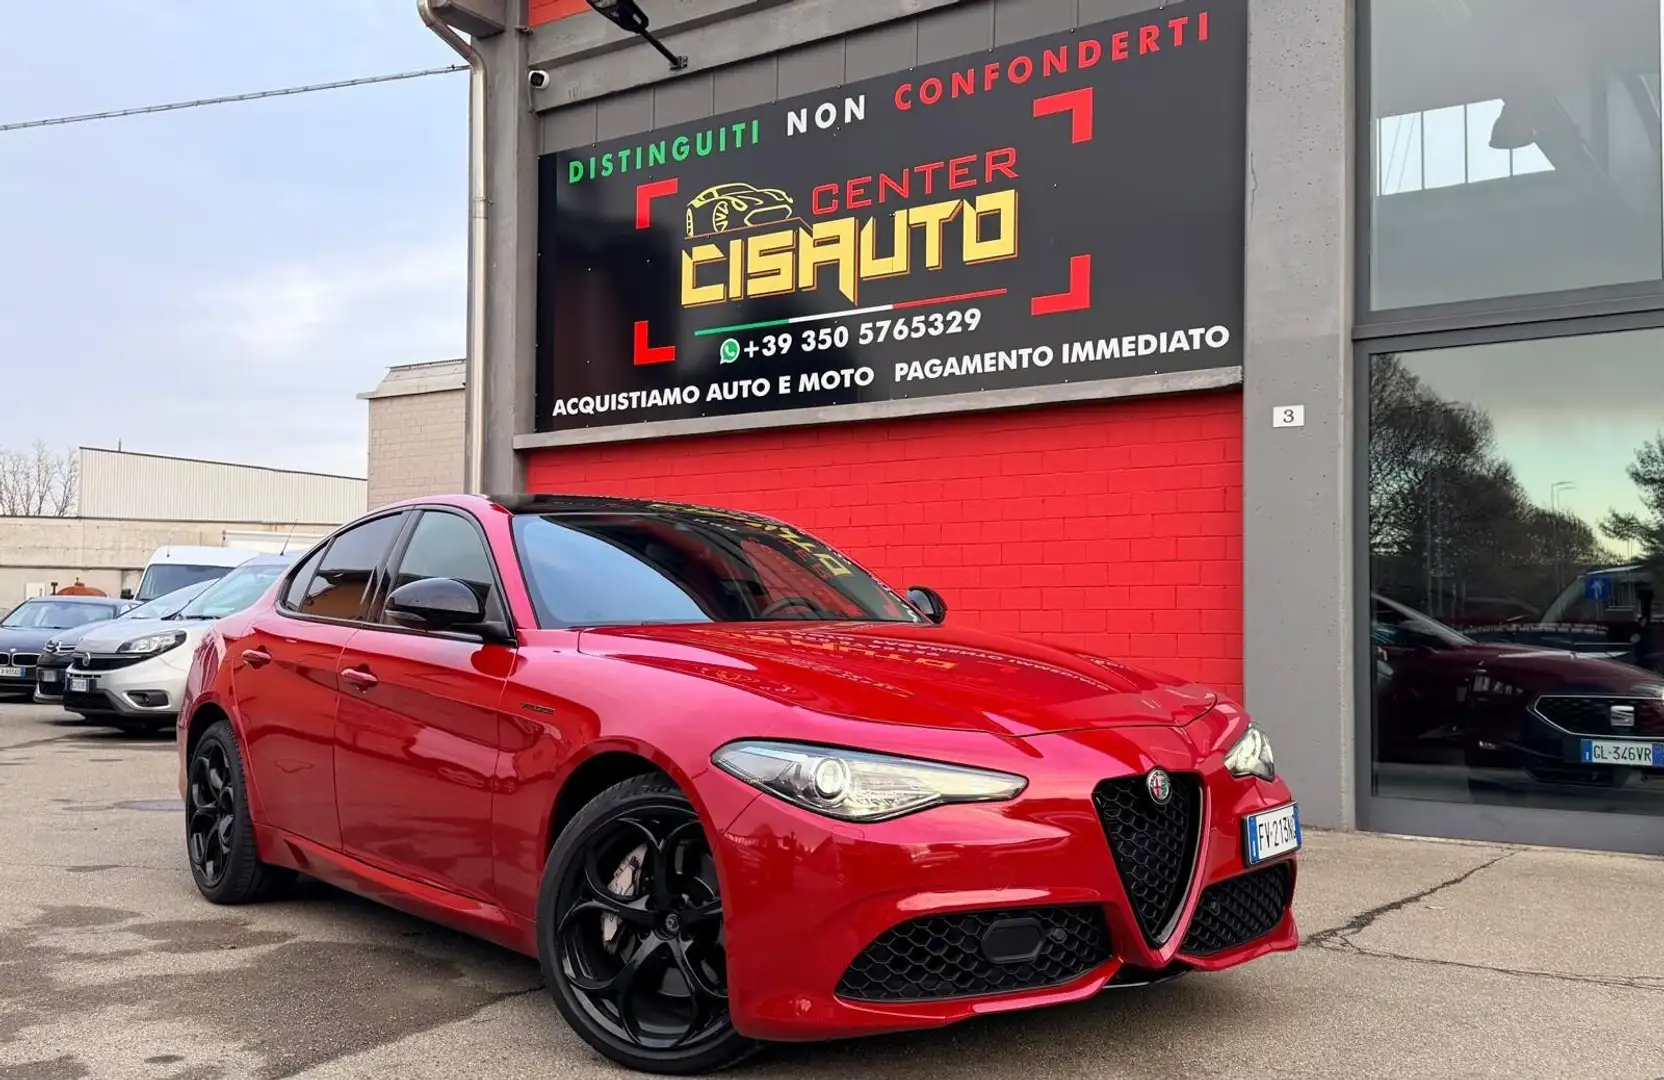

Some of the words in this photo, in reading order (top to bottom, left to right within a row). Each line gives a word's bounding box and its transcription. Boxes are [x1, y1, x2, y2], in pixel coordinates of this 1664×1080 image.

[568, 119, 759, 183] DISTINGUITI
[787, 94, 865, 136] NON
[894, 12, 1208, 111] CONFONDERTI
[812, 147, 1019, 214] CENTER
[681, 188, 1019, 308] CISAUTO
[552, 385, 700, 417] ACQUISTIAMO
[705, 377, 771, 402] AUTO
[778, 375, 791, 395] E
[798, 366, 875, 393] MOTO
[894, 345, 1054, 382] PAGAMENTO
[1061, 325, 1230, 364] IMMEDIATO
[743, 333, 793, 358] +39
[801, 325, 849, 352] 350
[858, 307, 982, 345] 5765329
[1283, 409, 1294, 423] 3
